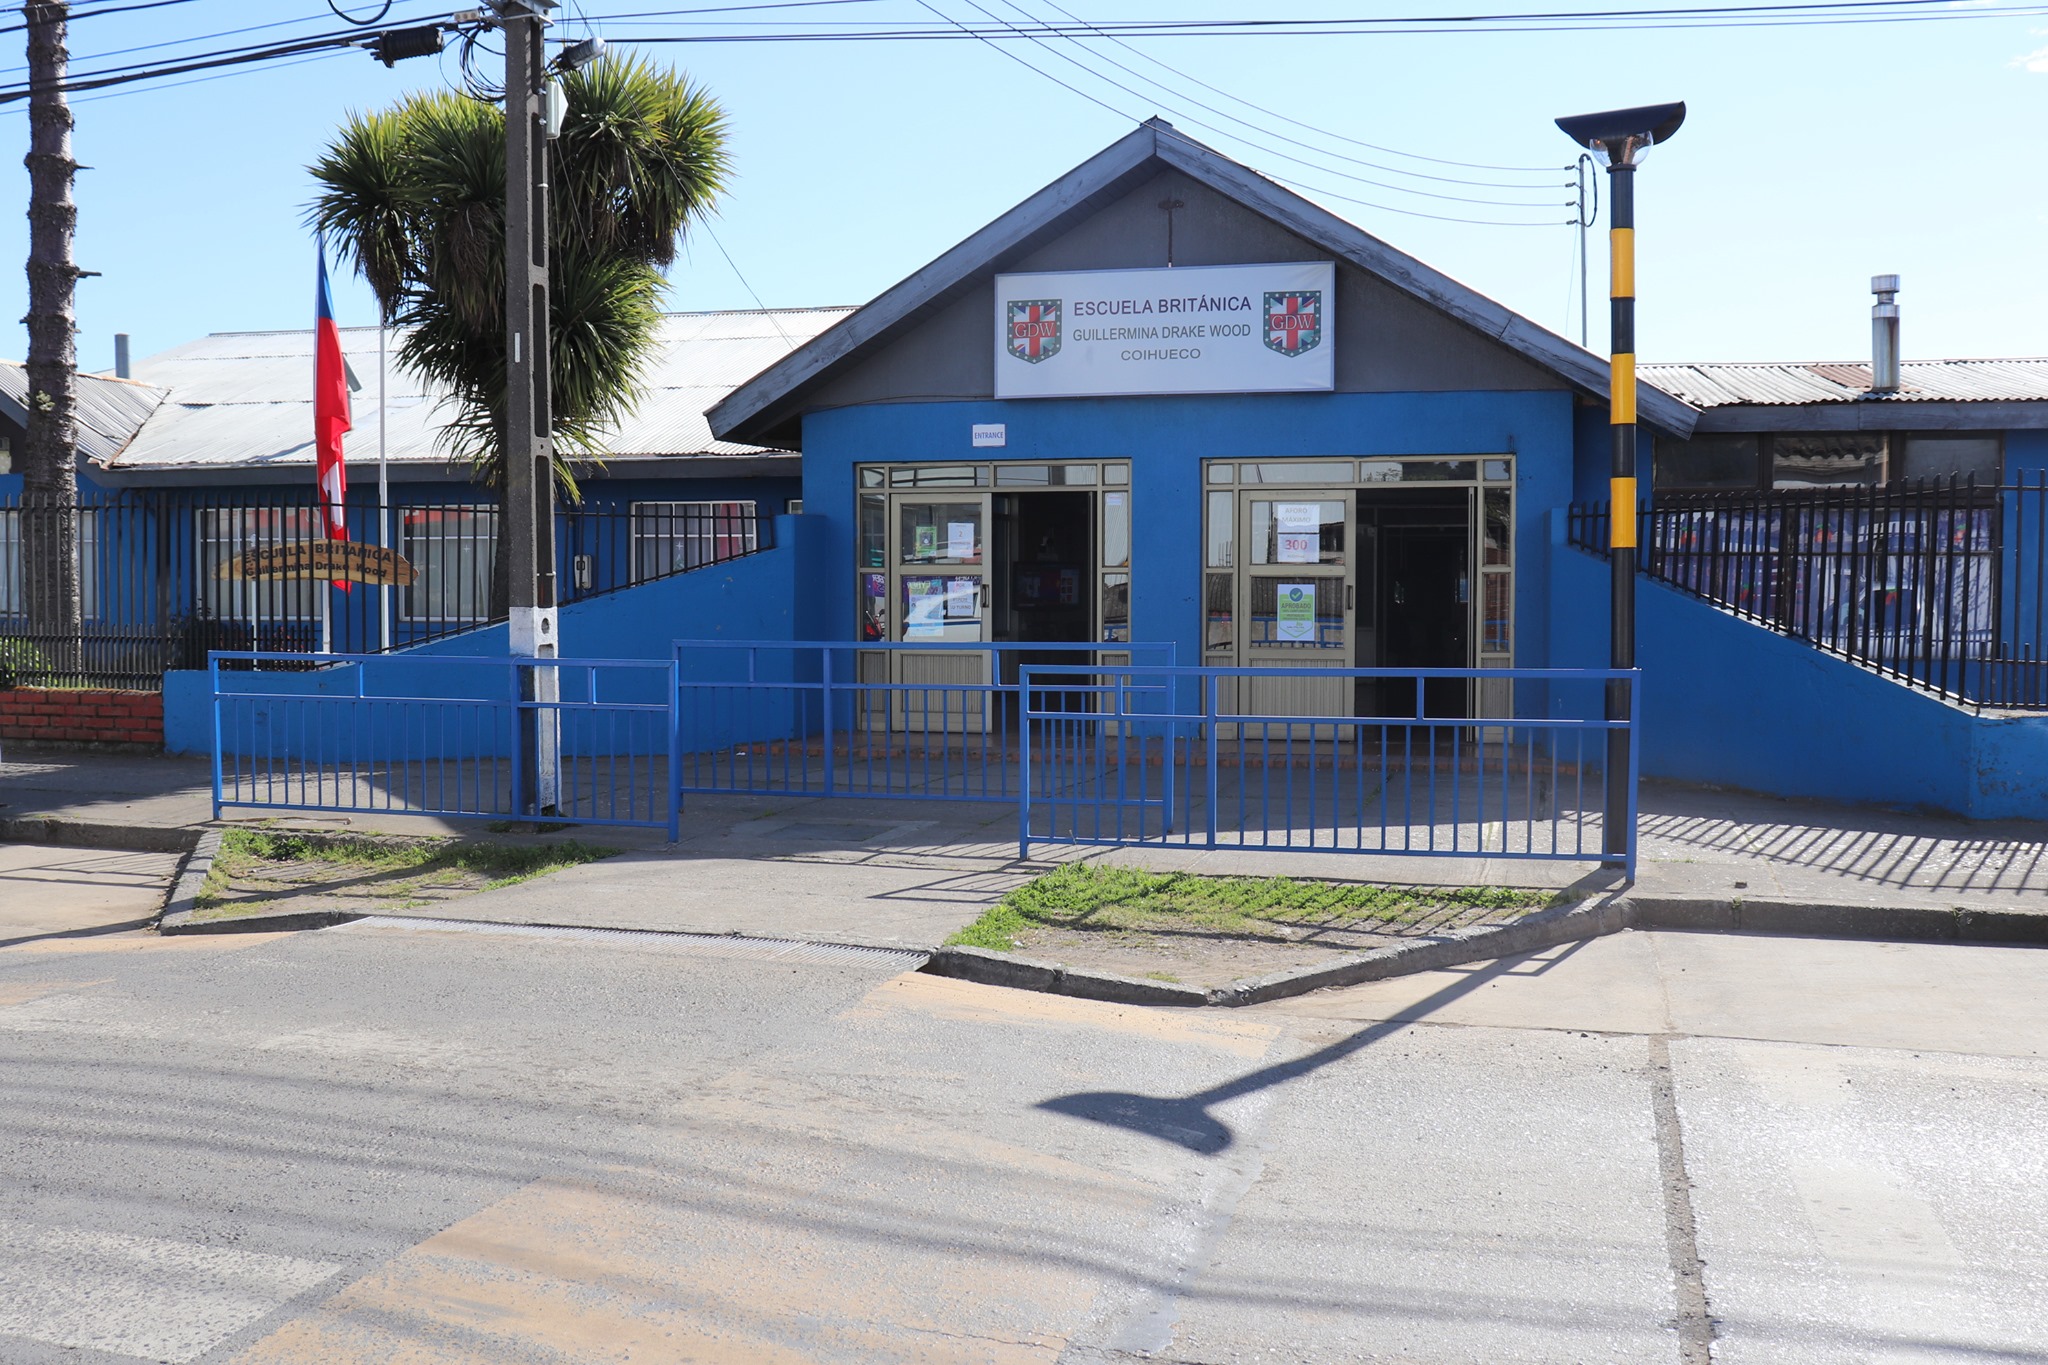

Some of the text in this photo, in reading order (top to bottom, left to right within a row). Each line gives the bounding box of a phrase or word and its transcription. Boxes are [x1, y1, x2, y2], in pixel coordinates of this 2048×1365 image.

[1074, 294, 1252, 316] ESCUELA BRITÁNICA
[1014, 322, 1054, 338] GDW
[1271, 314, 1314, 331] GDW
[1072, 324, 1251, 342] GUILLERMINA DRAKE WOOD
[1120, 348, 1201, 361] COIHUECO
[974, 431, 1004, 440] ENTRANCE
[1285, 539, 1308, 550] 300
